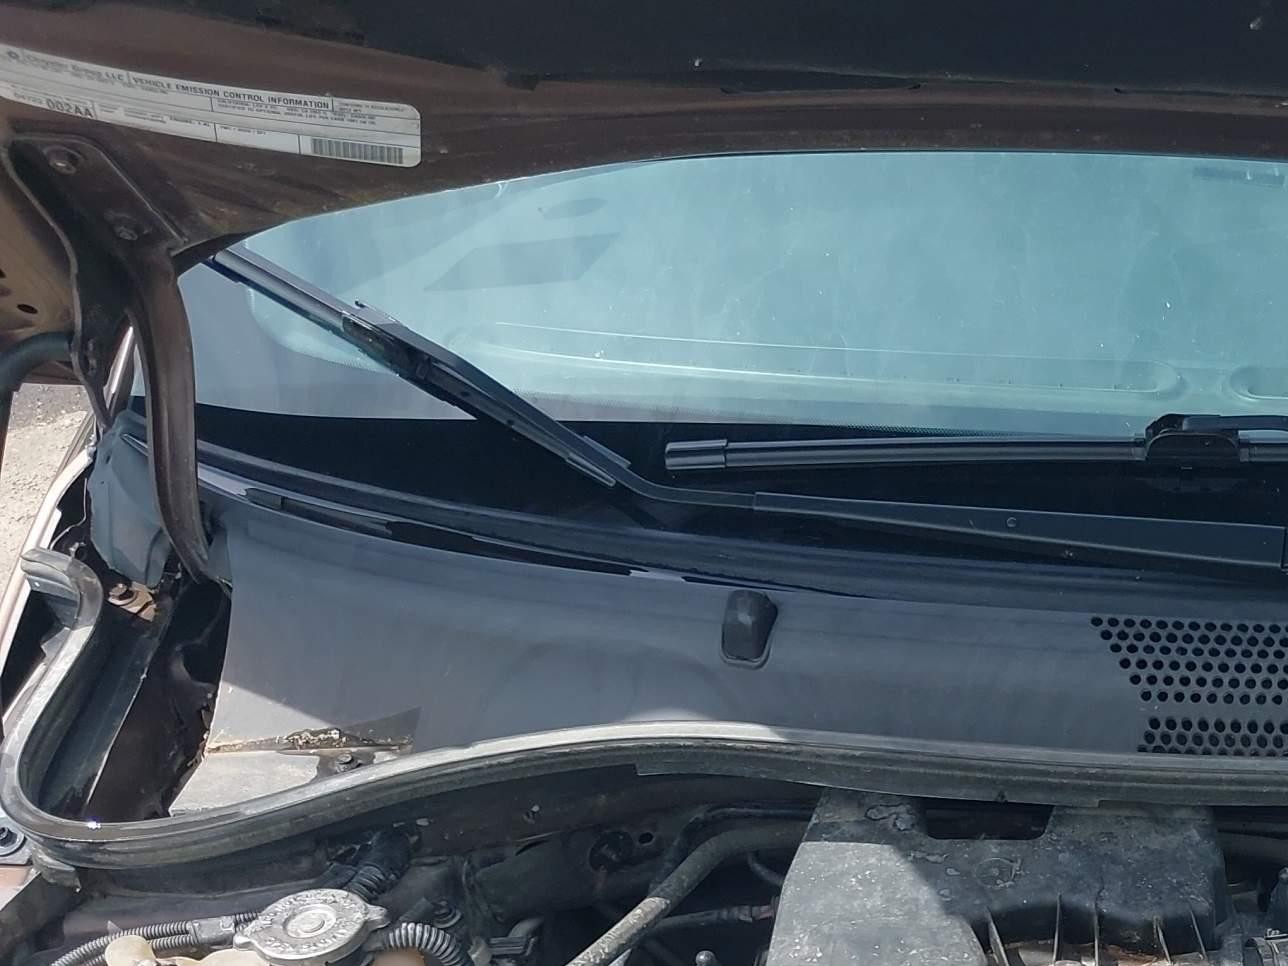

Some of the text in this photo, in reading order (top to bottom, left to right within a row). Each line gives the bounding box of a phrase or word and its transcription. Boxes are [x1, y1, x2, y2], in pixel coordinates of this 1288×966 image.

[132, 76, 172, 90] VEHICLE
[175, 83, 220, 97] EMISSION
[223, 89, 264, 103] CONTROL
[268, 95, 330, 109] INFORMATION
